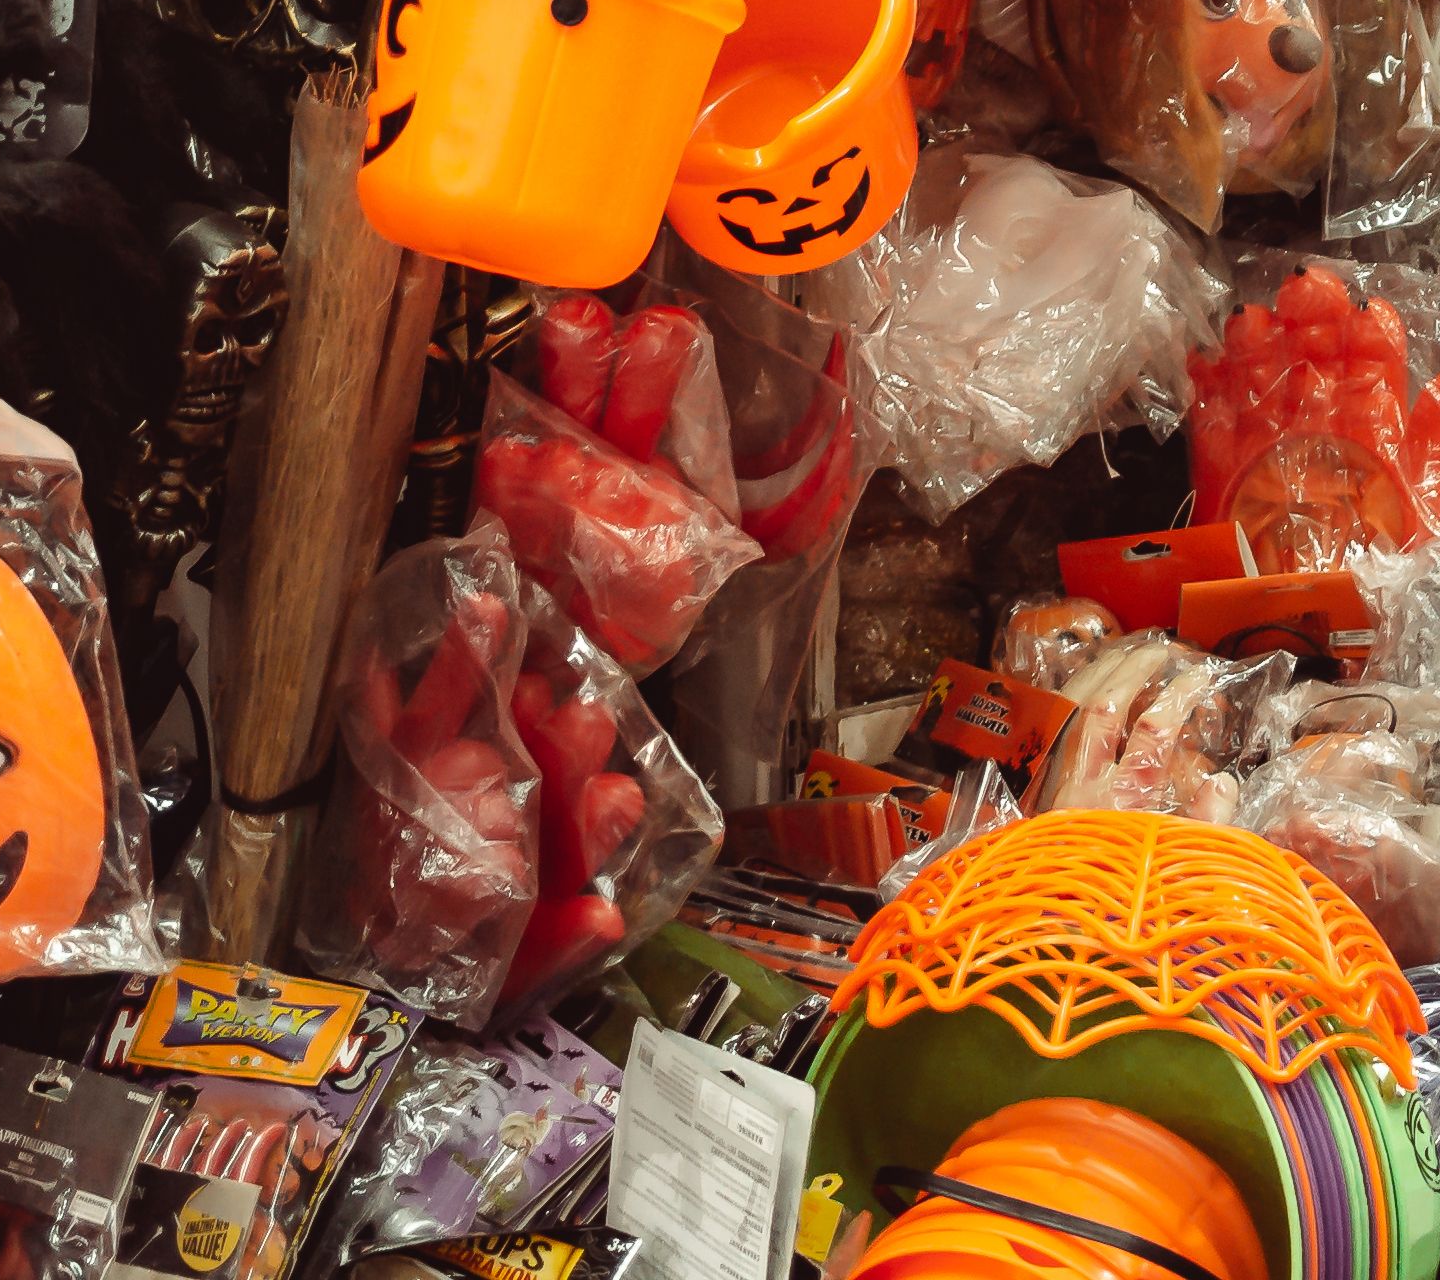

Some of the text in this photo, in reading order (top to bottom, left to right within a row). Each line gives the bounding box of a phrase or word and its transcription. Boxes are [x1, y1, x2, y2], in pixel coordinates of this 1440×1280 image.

[969, 695, 1009, 719] HAPPY
[955, 707, 1011, 737] HALLOWEEN
[182, 990, 325, 1036] PATY
[388, 1010, 409, 1026] 3+
[200, 1022, 296, 1044] WEAPON
[181, 1229, 228, 1262] VALUE!
